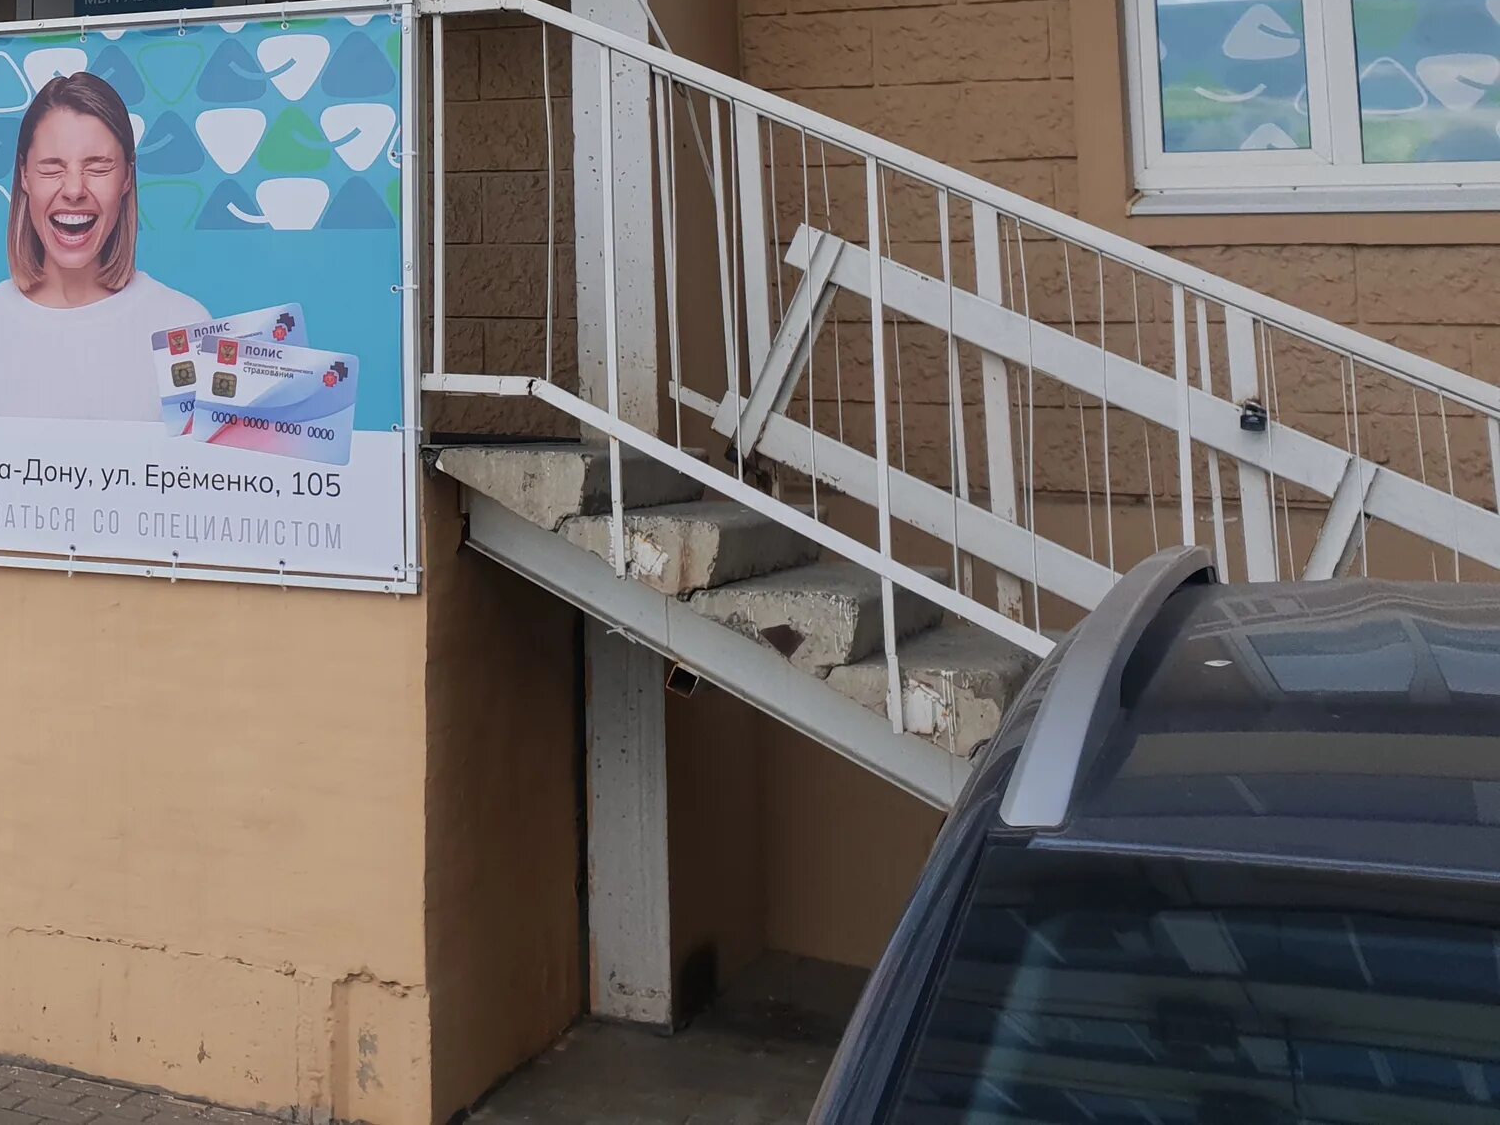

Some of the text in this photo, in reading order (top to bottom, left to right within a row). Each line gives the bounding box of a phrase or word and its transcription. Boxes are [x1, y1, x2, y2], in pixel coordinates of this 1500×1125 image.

[193, 321, 232, 339] ПОЛИС
[244, 344, 284, 360] ПОЛИС
[242, 366, 295, 380] страхования
[211, 410, 335, 441] 0000 0000 0000 0000
[100, 467, 137, 492] ул.
[145, 463, 282, 498] Ерёменко,
[291, 471, 342, 498] 105
[92, 508, 120, 535] СО
[137, 510, 342, 550] СПЕЦИАЛИСТОМ
